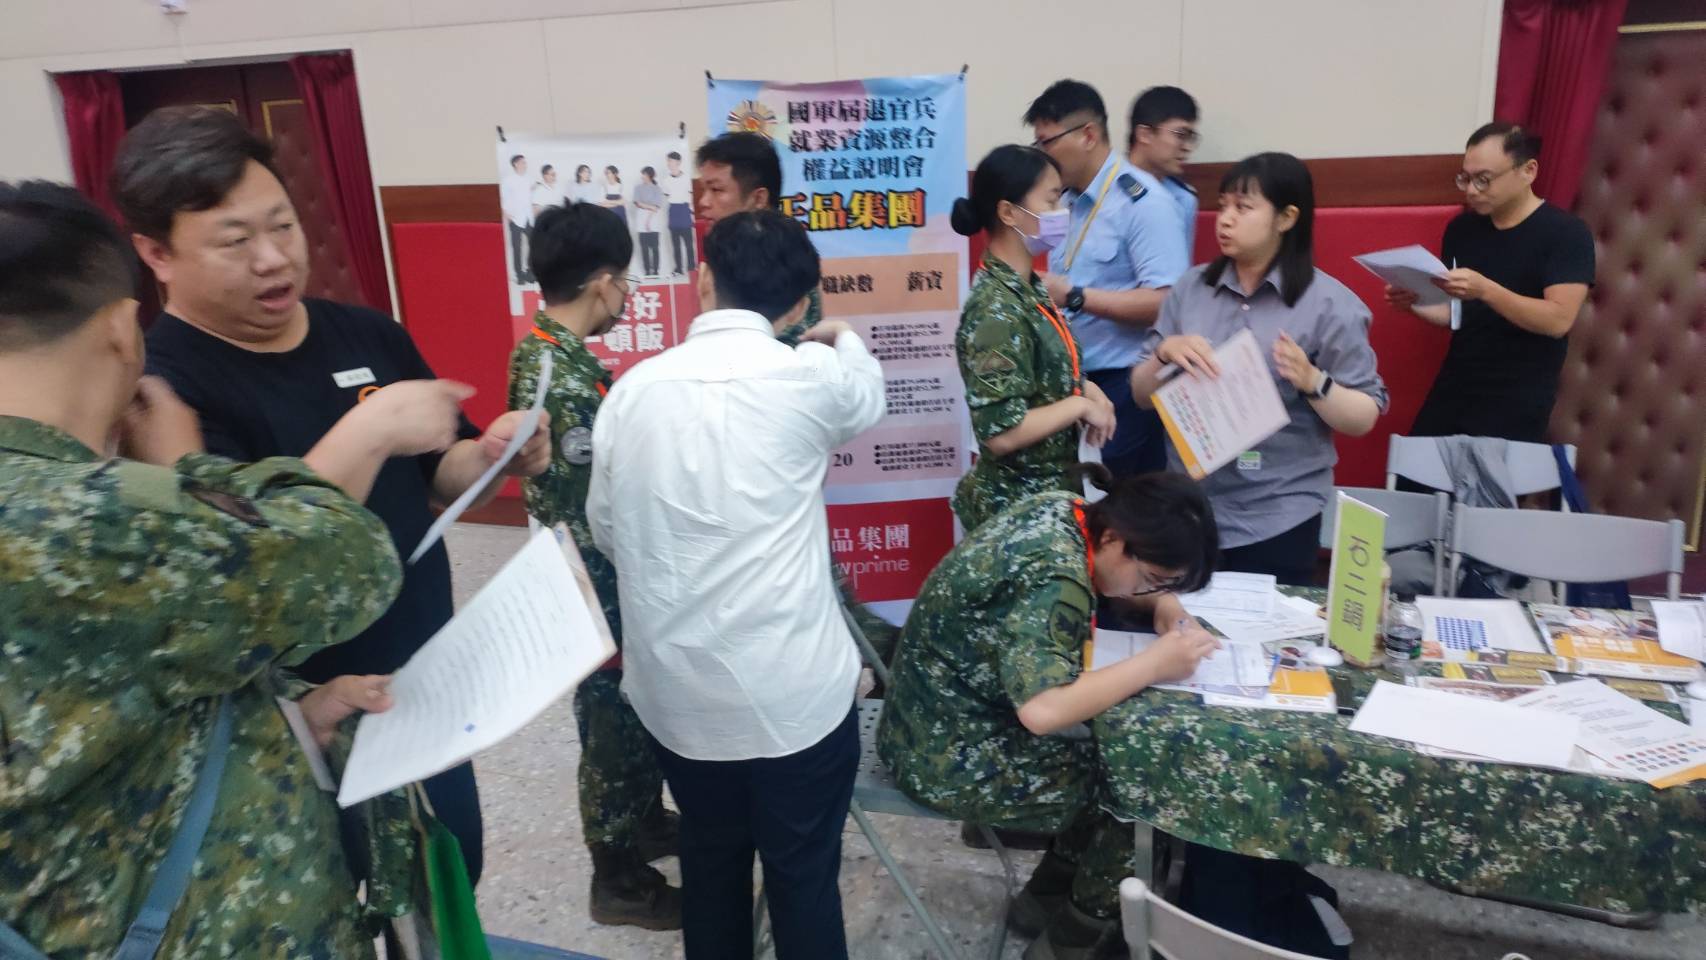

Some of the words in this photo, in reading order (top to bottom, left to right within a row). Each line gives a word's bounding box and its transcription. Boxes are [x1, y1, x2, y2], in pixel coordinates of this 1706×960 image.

[788, 126, 937, 152] 就業資源整合
[833, 452, 853, 468] 20
